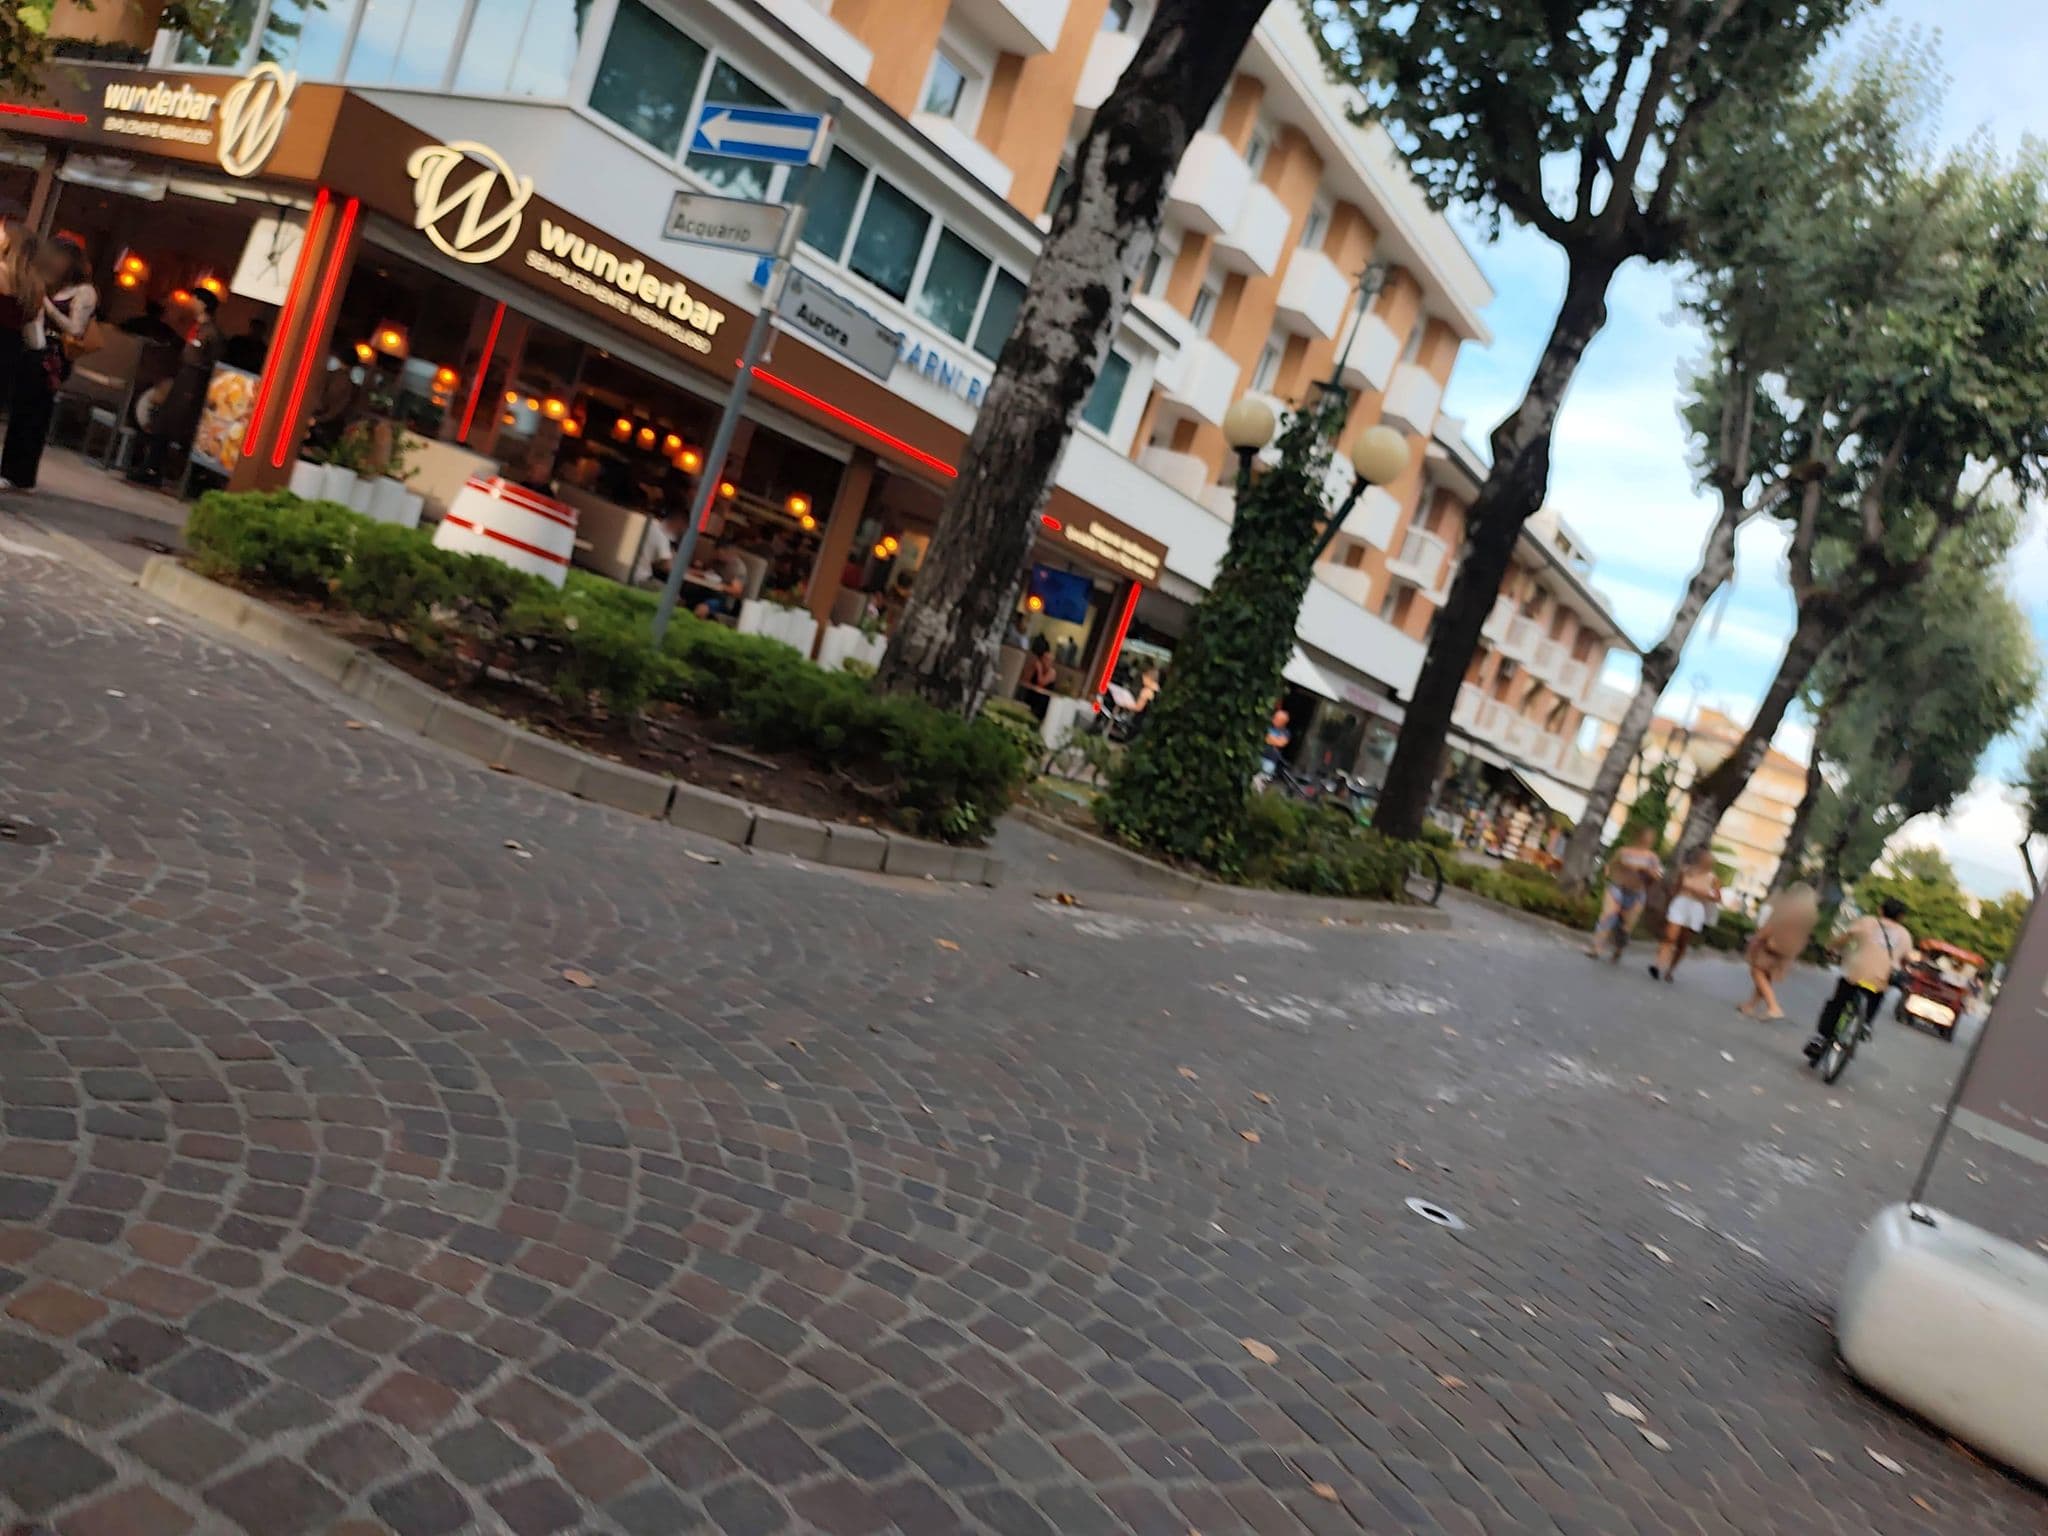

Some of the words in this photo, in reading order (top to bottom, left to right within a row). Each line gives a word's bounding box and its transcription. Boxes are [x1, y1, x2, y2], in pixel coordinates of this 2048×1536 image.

[104, 81, 217, 121] wunderbar
[674, 213, 751, 242] Acquario
[540, 218, 725, 335] wunderbar
[796, 303, 849, 347] Aurora
